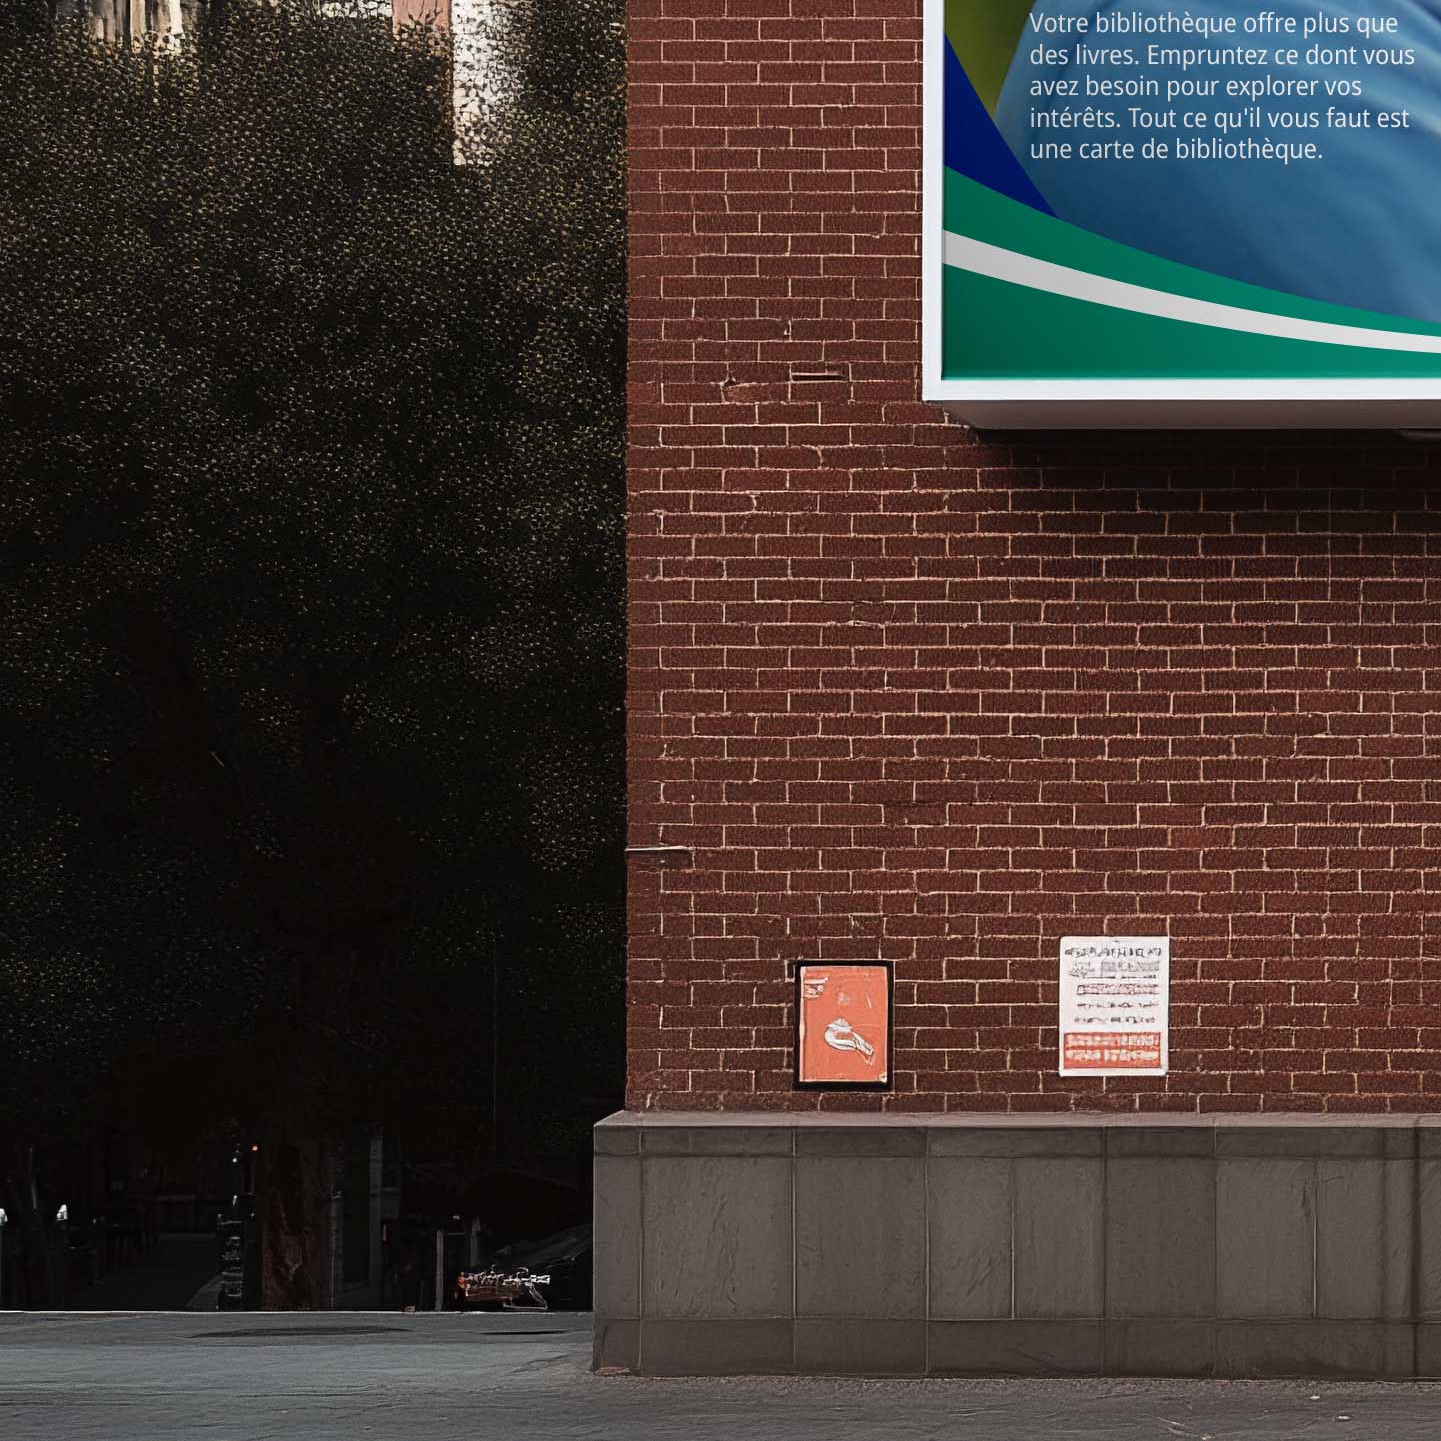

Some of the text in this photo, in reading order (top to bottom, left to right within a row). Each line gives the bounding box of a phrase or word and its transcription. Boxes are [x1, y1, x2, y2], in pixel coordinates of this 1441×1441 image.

[1028, 10, 1399, 40] Votre bibliothèque offre plus que
[1029, 42, 1416, 72] des livres. Empruntez ce dont vous
[1029, 73, 1363, 103] avez besoin pour explorer vos
[1030, 105, 1410, 135] intérêts. Tout ce qu'il vous faut est
[1030, 135, 1323, 166] une carte de bibliothèque.
